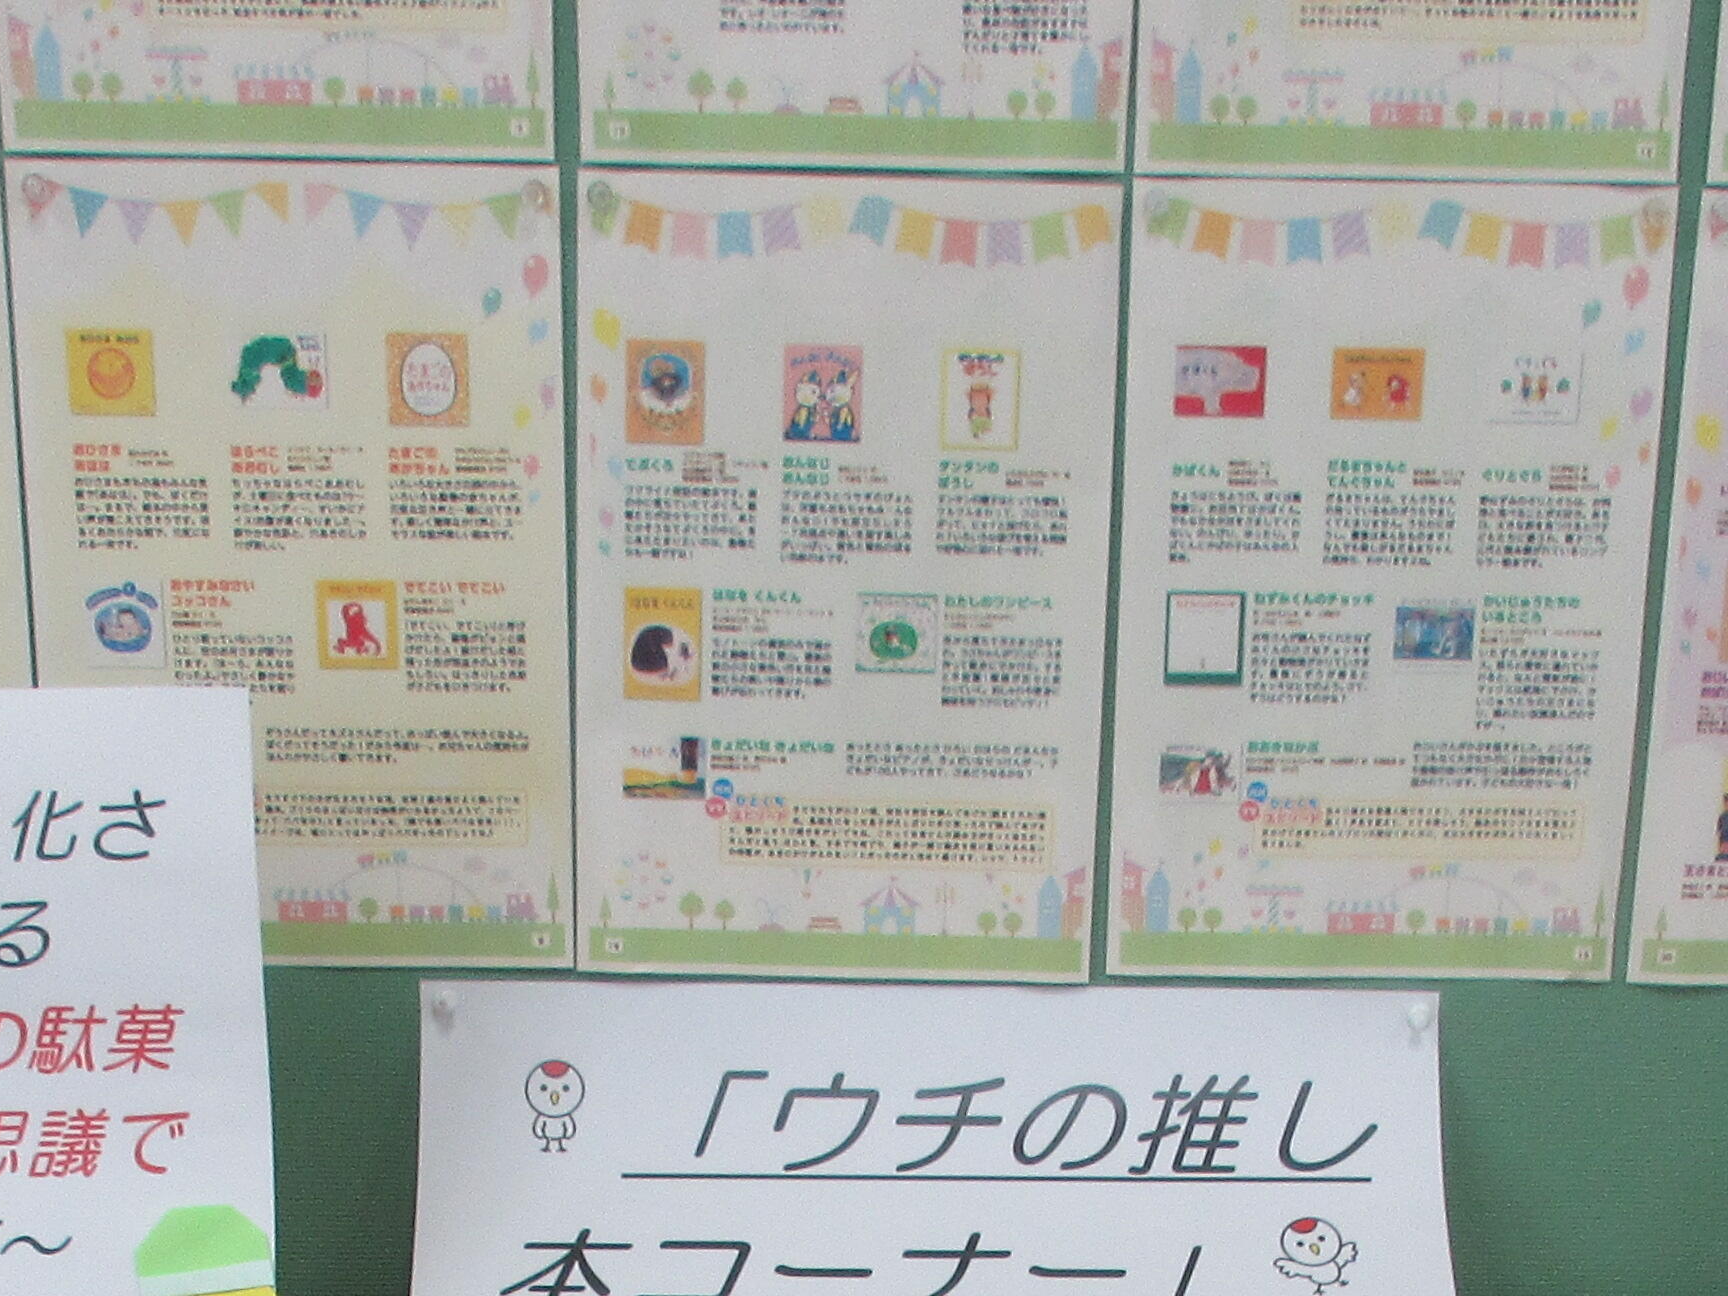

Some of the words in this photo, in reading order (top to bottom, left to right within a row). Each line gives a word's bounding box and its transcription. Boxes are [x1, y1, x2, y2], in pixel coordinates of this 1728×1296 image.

[692, 1068, 1379, 1176] 「ウチの推し
